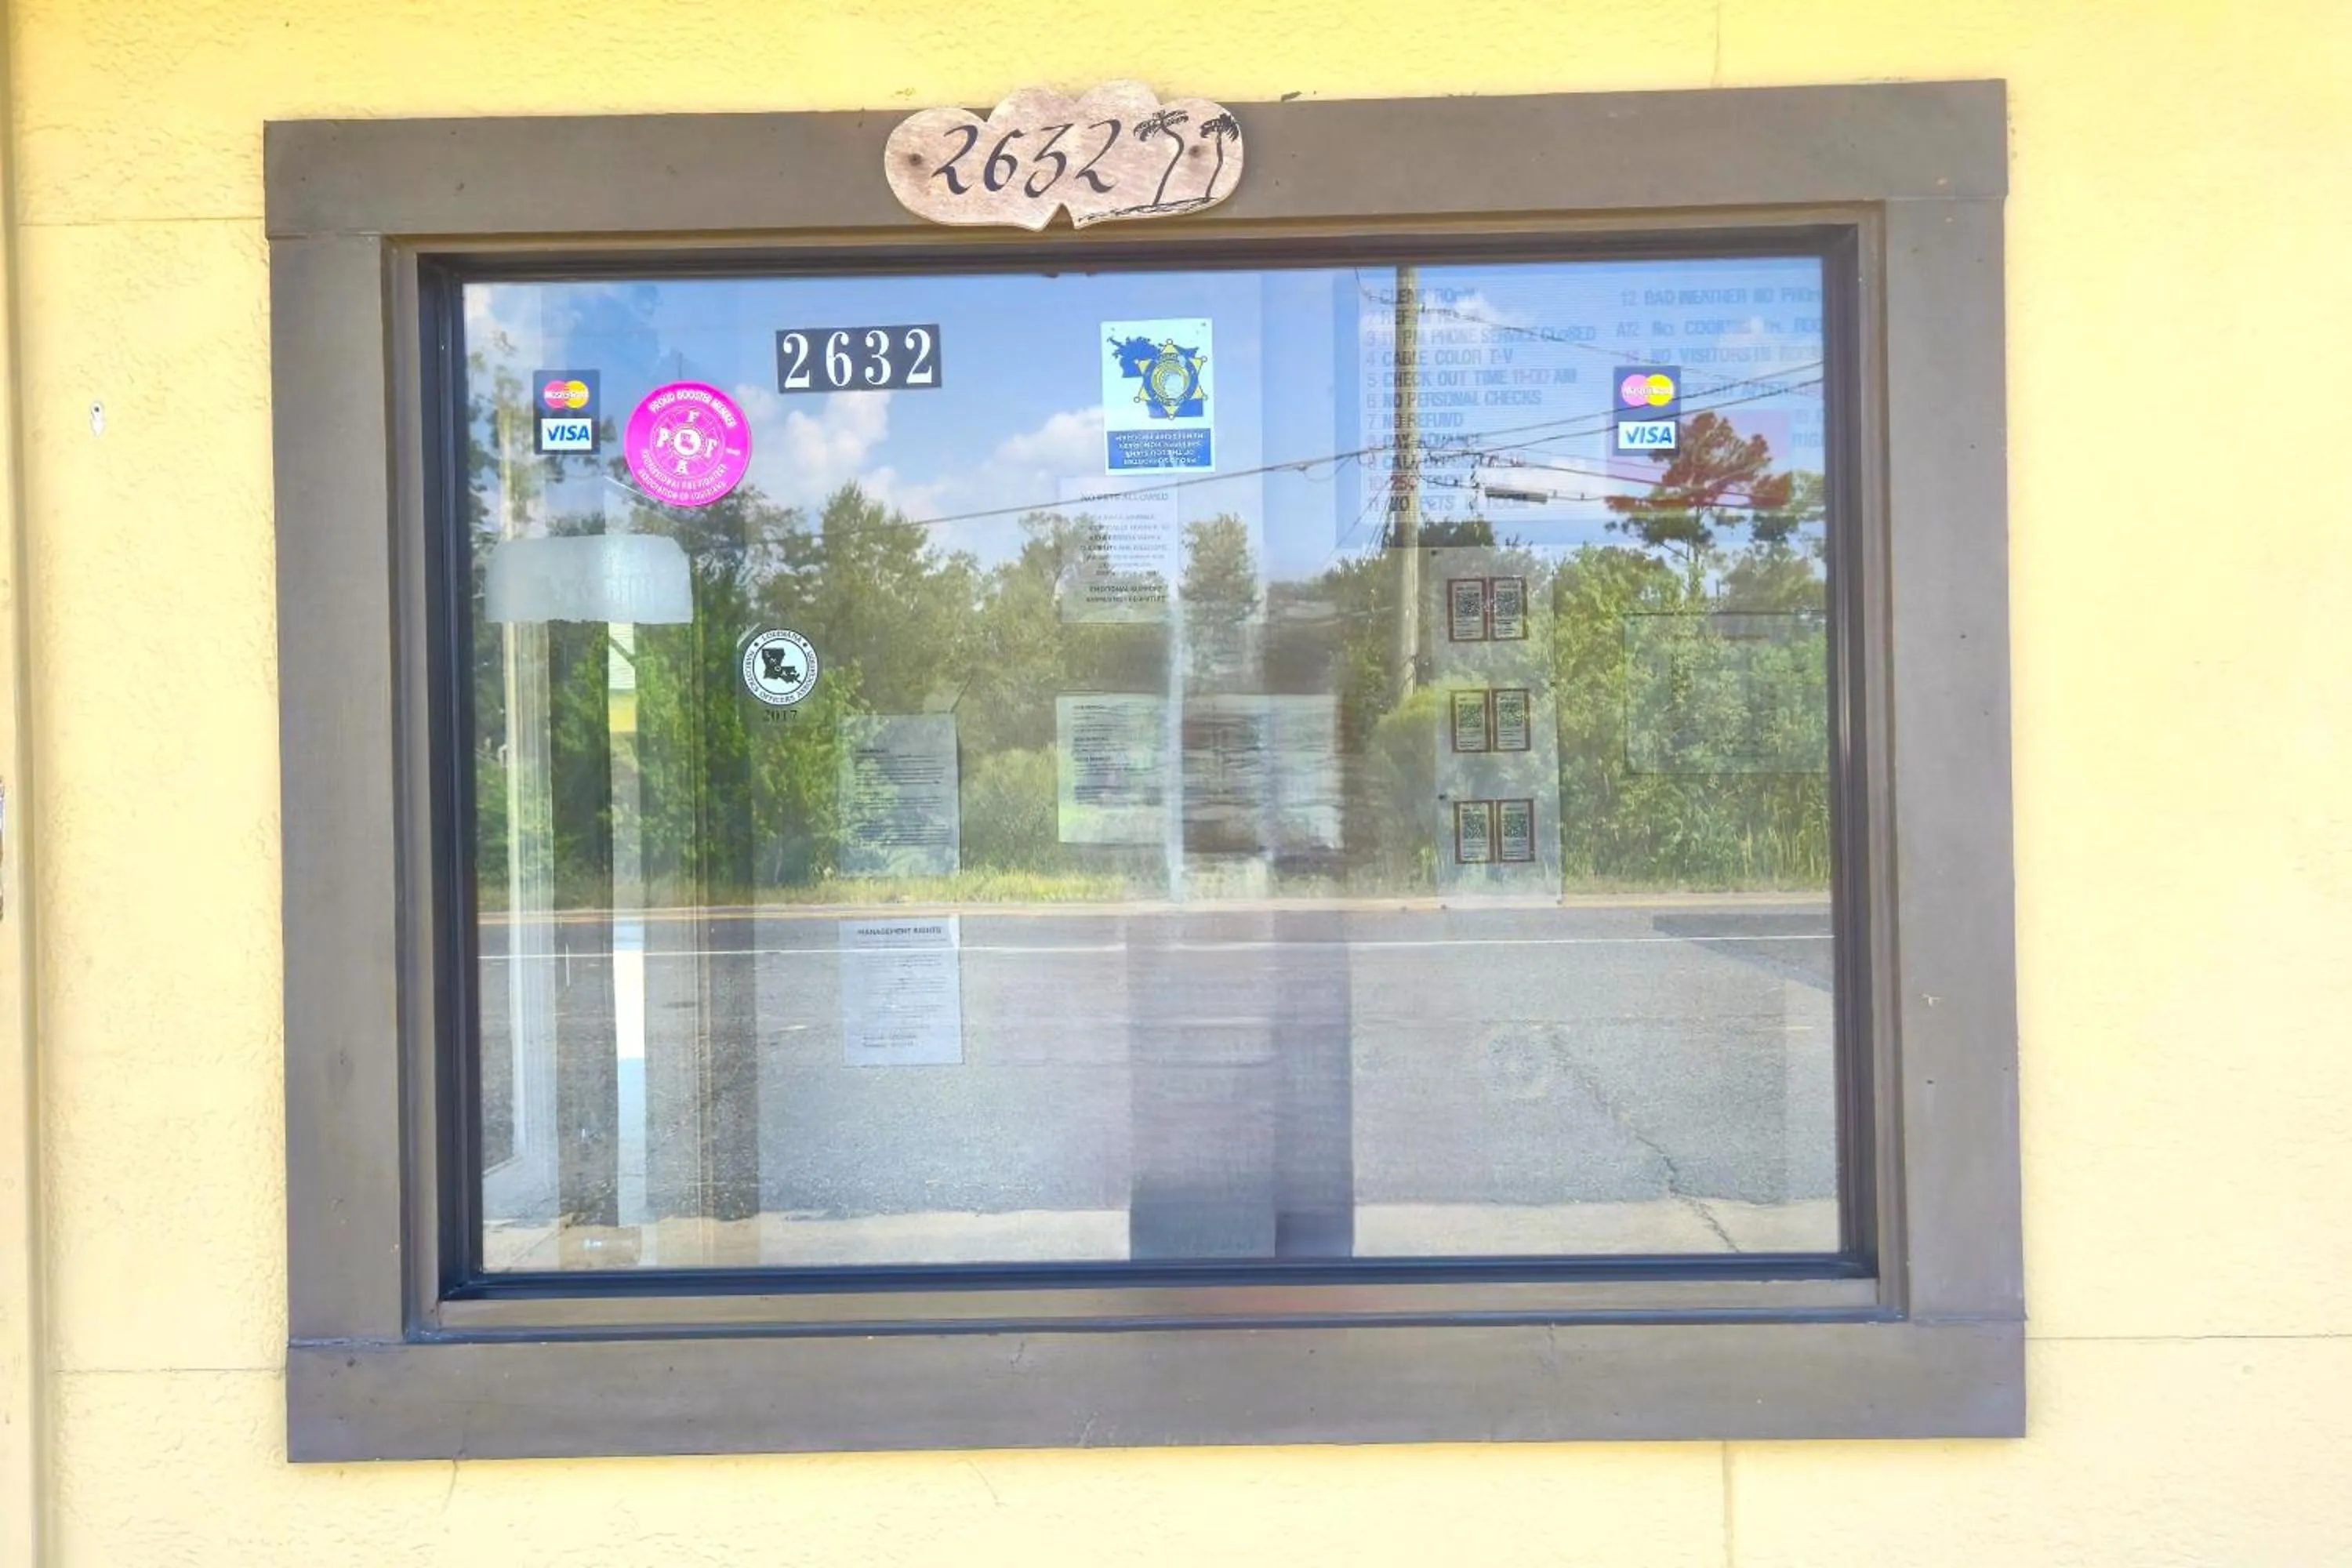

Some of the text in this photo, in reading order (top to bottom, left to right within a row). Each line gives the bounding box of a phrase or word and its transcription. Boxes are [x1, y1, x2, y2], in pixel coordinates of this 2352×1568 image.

[931, 119, 1121, 198] 2632
[783, 328, 932, 388] 2632
[1382, 350, 1428, 366] CABLE
[1435, 349, 1481, 365] COLOR
[1383, 371, 1431, 387] CHECK
[1438, 370, 1467, 387] OUT
[1474, 370, 1507, 385] TIME
[1383, 392, 1403, 408] NO
[1407, 391, 1479, 407] PERSONAL
[1485, 390, 1541, 405] CHECKS
[1382, 412, 1402, 428] NO
[1408, 412, 1463, 428] REFUND
[546, 424, 590, 441] VISA
[1625, 426, 1672, 444] VISA
[857, 926, 942, 936] MANAGEMENT RIGHTS
